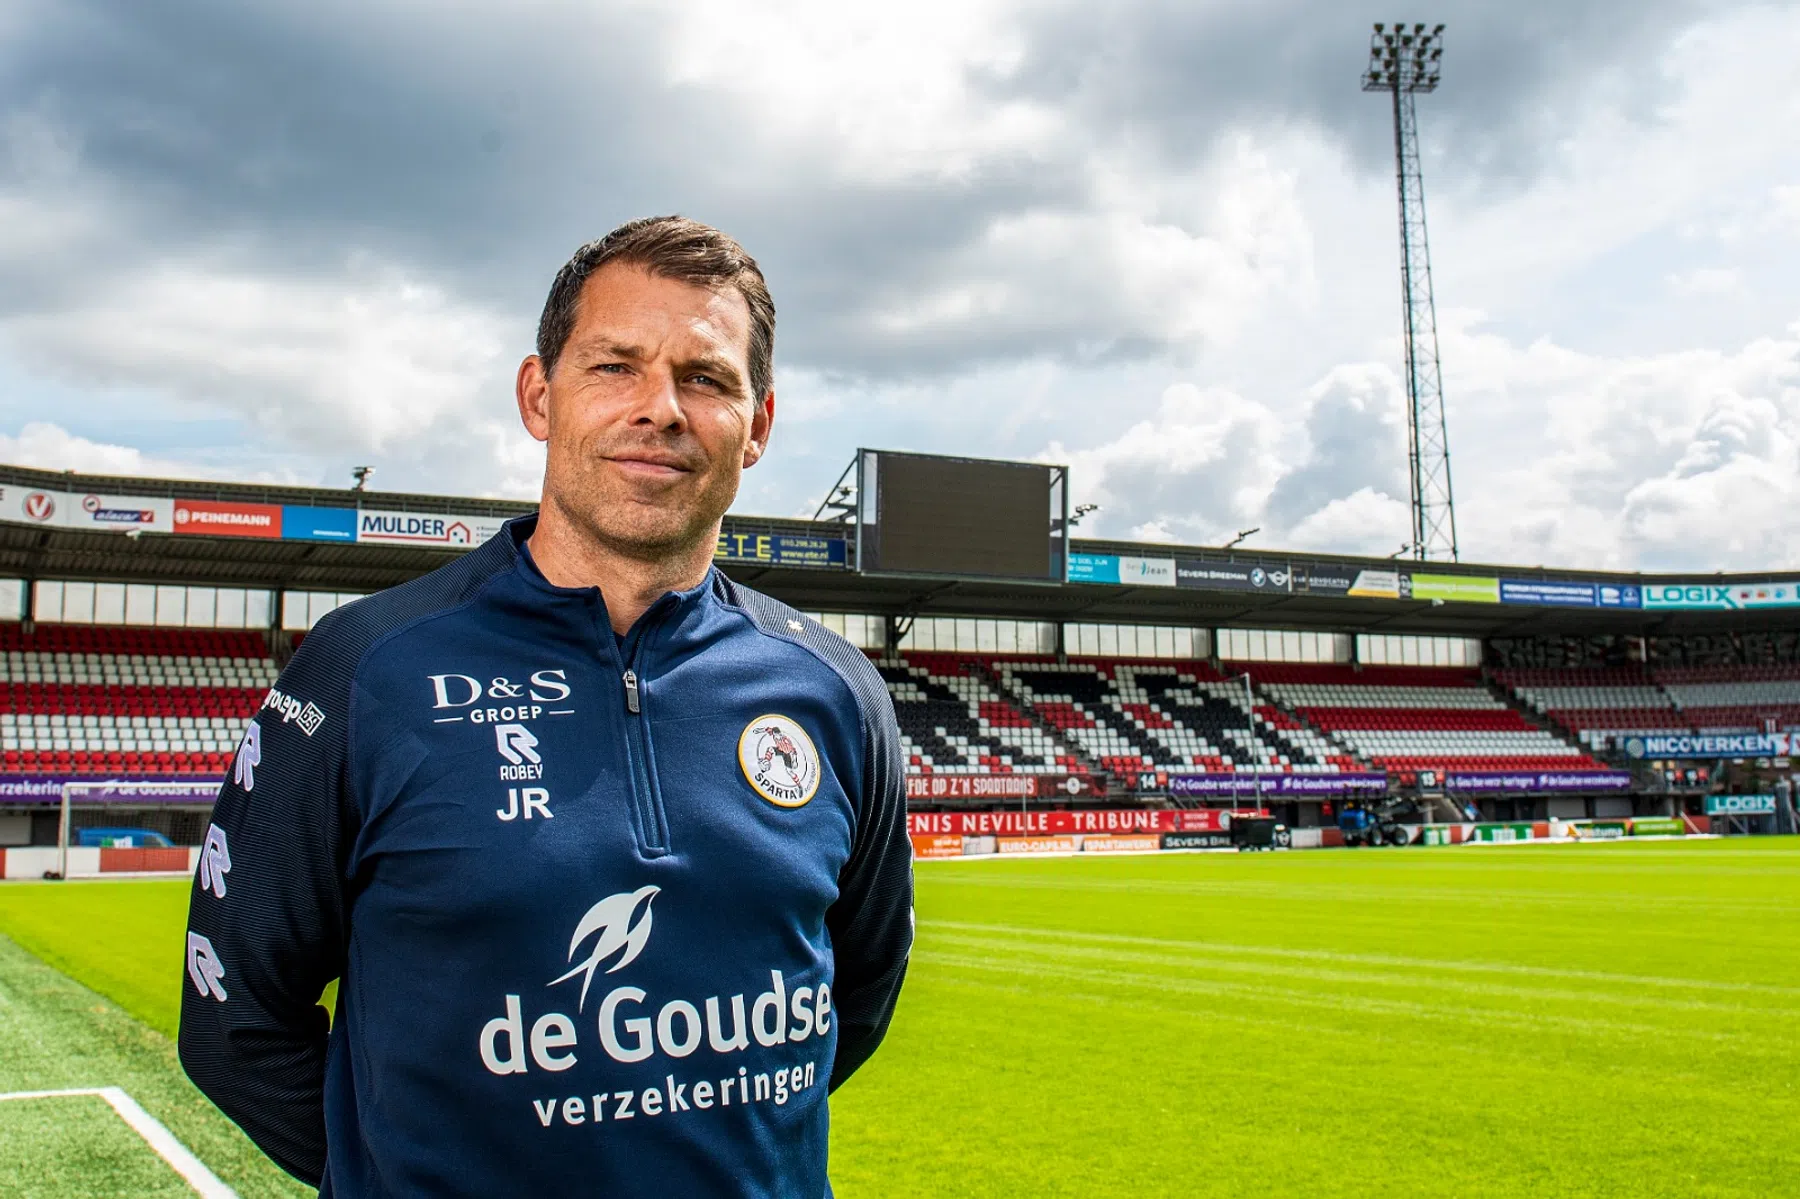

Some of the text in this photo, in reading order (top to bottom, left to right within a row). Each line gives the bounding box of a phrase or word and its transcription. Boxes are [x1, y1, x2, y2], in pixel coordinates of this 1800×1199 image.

[191, 511, 271, 526] PEINEMANN
[361, 515, 445, 536] MULDER
[1646, 586, 1735, 603] LOGIX
[427, 669, 571, 709] D&S
[261, 688, 302, 723] roep
[470, 706, 542, 724] GROEP
[500, 764, 543, 780] ROBEY
[1140, 774, 1156, 788] 14
[754, 772, 797, 800] SPARTA
[906, 778, 929, 795] FDE
[496, 787, 554, 822] JR
[1715, 795, 1777, 810] LOGIX
[963, 813, 1048, 832] NEVILLE
[1072, 811, 1160, 830] TRIBUNE
[480, 969, 832, 1076] de Goudse
[533, 1060, 815, 1128] verzekeringen
